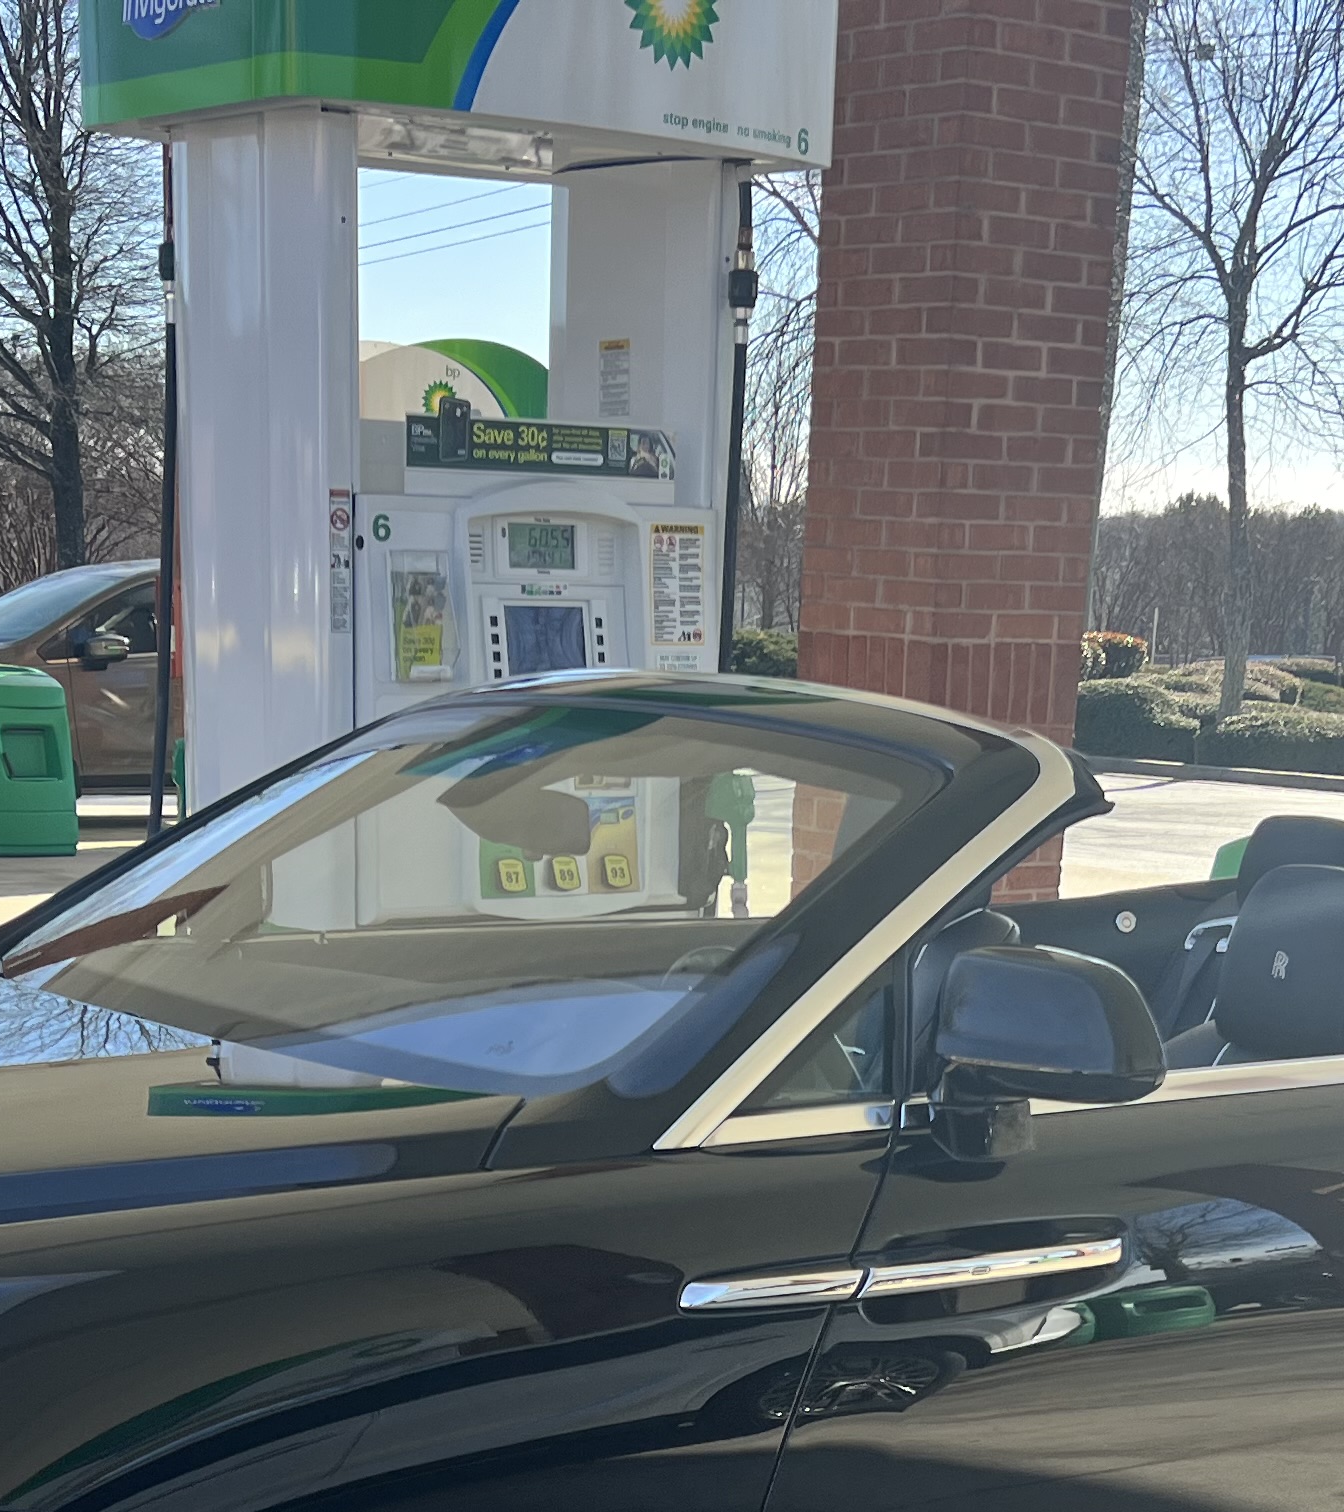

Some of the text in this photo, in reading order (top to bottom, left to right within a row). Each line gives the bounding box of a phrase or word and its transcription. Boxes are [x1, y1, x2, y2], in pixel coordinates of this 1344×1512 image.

[662, 112, 792, 148] stop engine no smoking
[797, 127, 809, 155] 6
[445, 364, 461, 381] bp
[472, 422, 514, 446] Save
[518, 425, 548, 449] 30¢
[472, 447, 486, 460] on
[488, 450, 515, 463] every
[517, 449, 548, 464] gallon
[372, 514, 391, 541] 6
[661, 525, 699, 534] WARNING
[506, 866, 625, 884] 87 89 93
